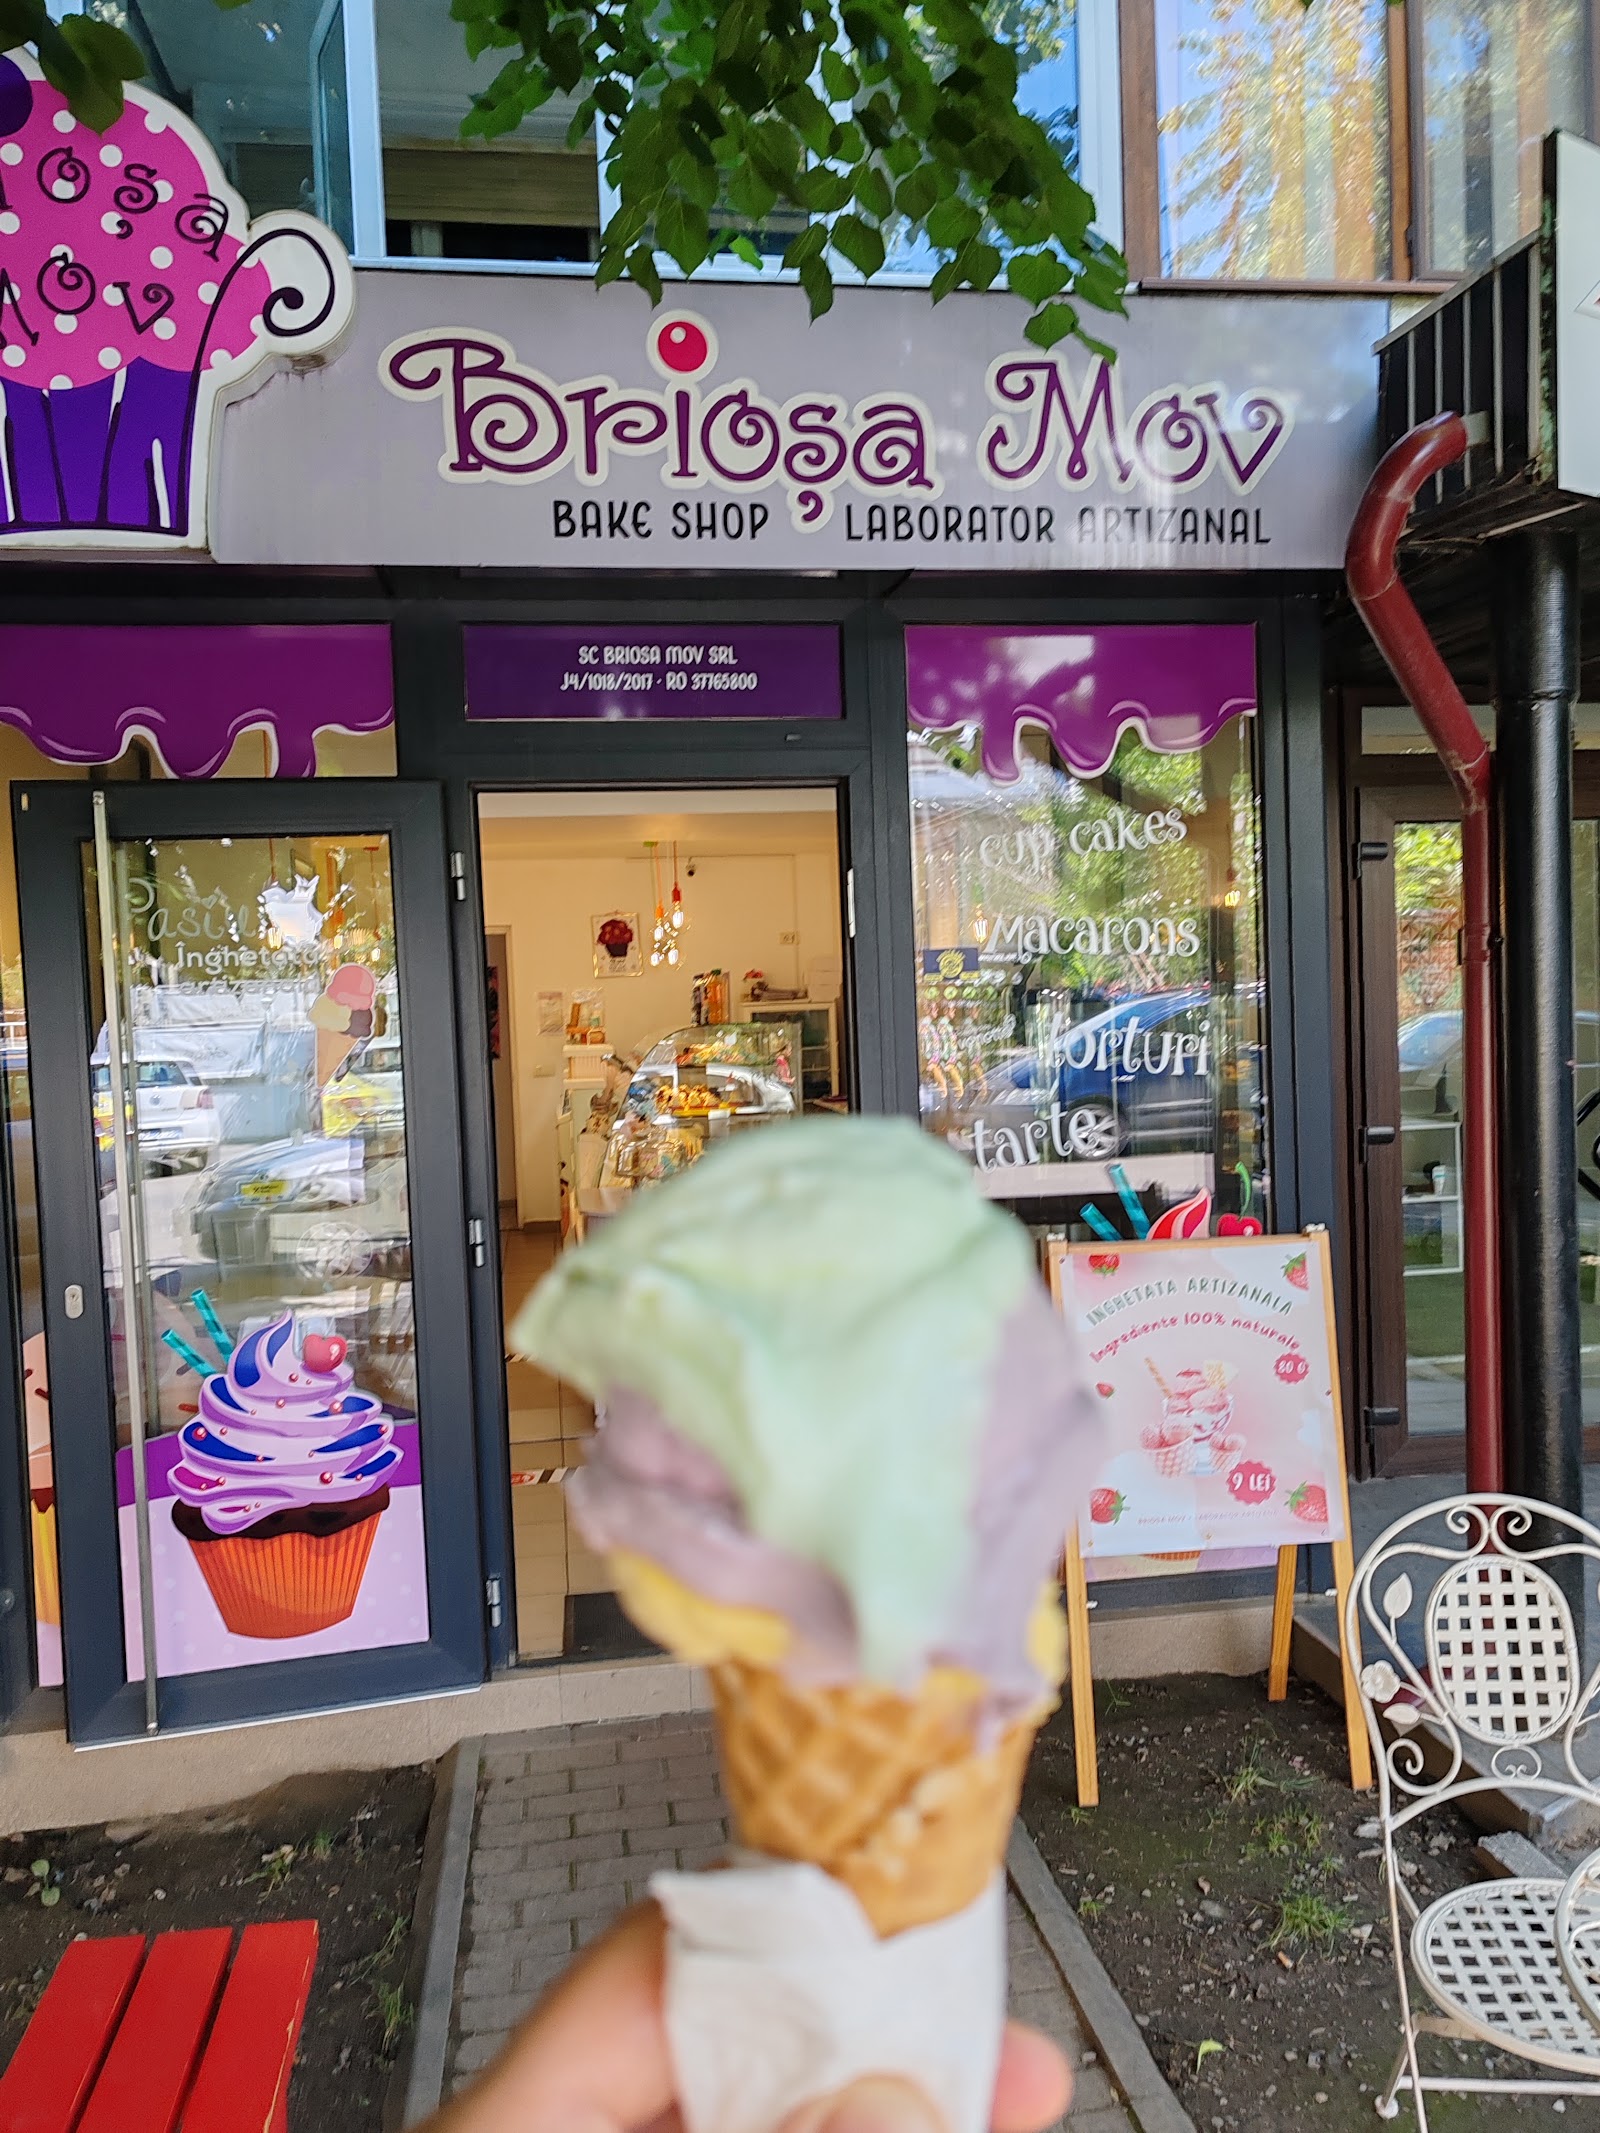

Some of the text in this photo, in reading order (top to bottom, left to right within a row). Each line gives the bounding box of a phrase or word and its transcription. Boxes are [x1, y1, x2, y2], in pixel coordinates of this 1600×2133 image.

[987, 356, 1286, 486] Mov
[553, 500, 1271, 546] BAKE SHOP LABORATOR ARTIZANAL
[578, 645, 738, 665] SC BRIOSA MOV SRL
[665, 671, 688, 691] RO
[979, 807, 1188, 876] cup cakes
[982, 915, 1201, 958] Macarons
[1045, 1012, 1210, 1077] torturi
[971, 1098, 1098, 1174] tarte
[1187, 1276, 1293, 1317] ARTIZANALA
[1184, 1311, 1226, 1326] 100%
[1231, 1316, 1300, 1351] naturale
[1231, 1471, 1244, 1491] 9
